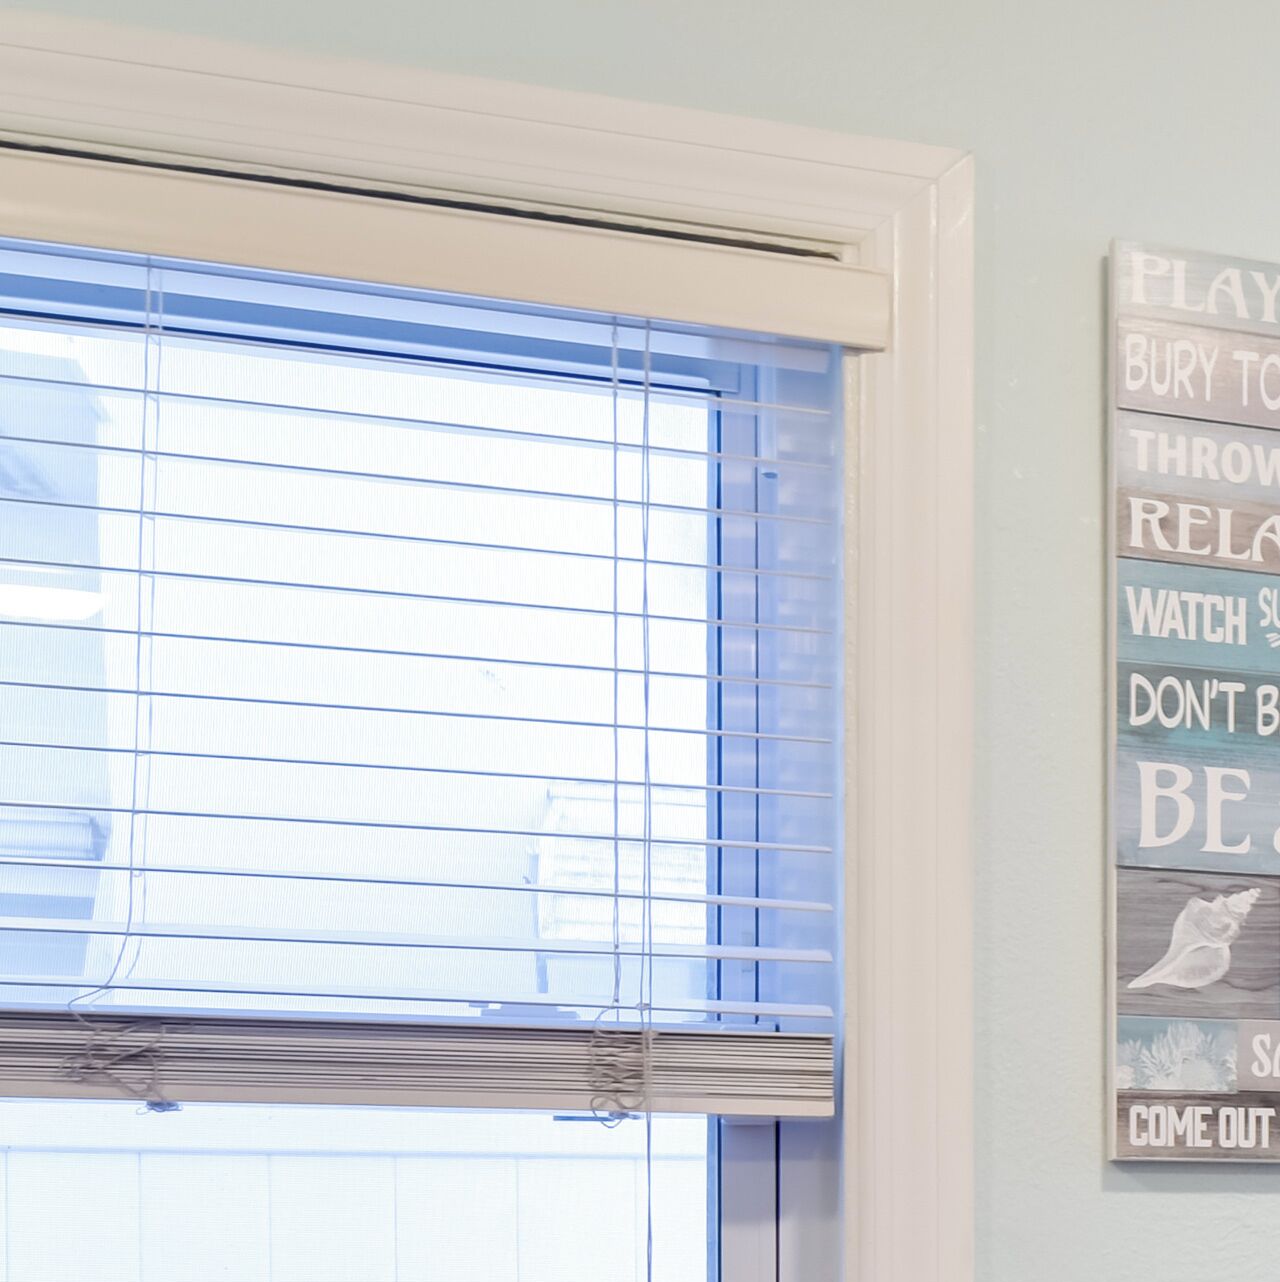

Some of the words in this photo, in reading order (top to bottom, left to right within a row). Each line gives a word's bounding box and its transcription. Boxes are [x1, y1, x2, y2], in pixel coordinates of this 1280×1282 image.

[1125, 333, 1219, 402] BURY
[1125, 585, 1247, 646] WATCH
[1129, 673, 1245, 733] DON'T
[1136, 760, 1252, 854] BE
[1129, 1105, 1213, 1148] COME
[1218, 1106, 1276, 1149] OUT
